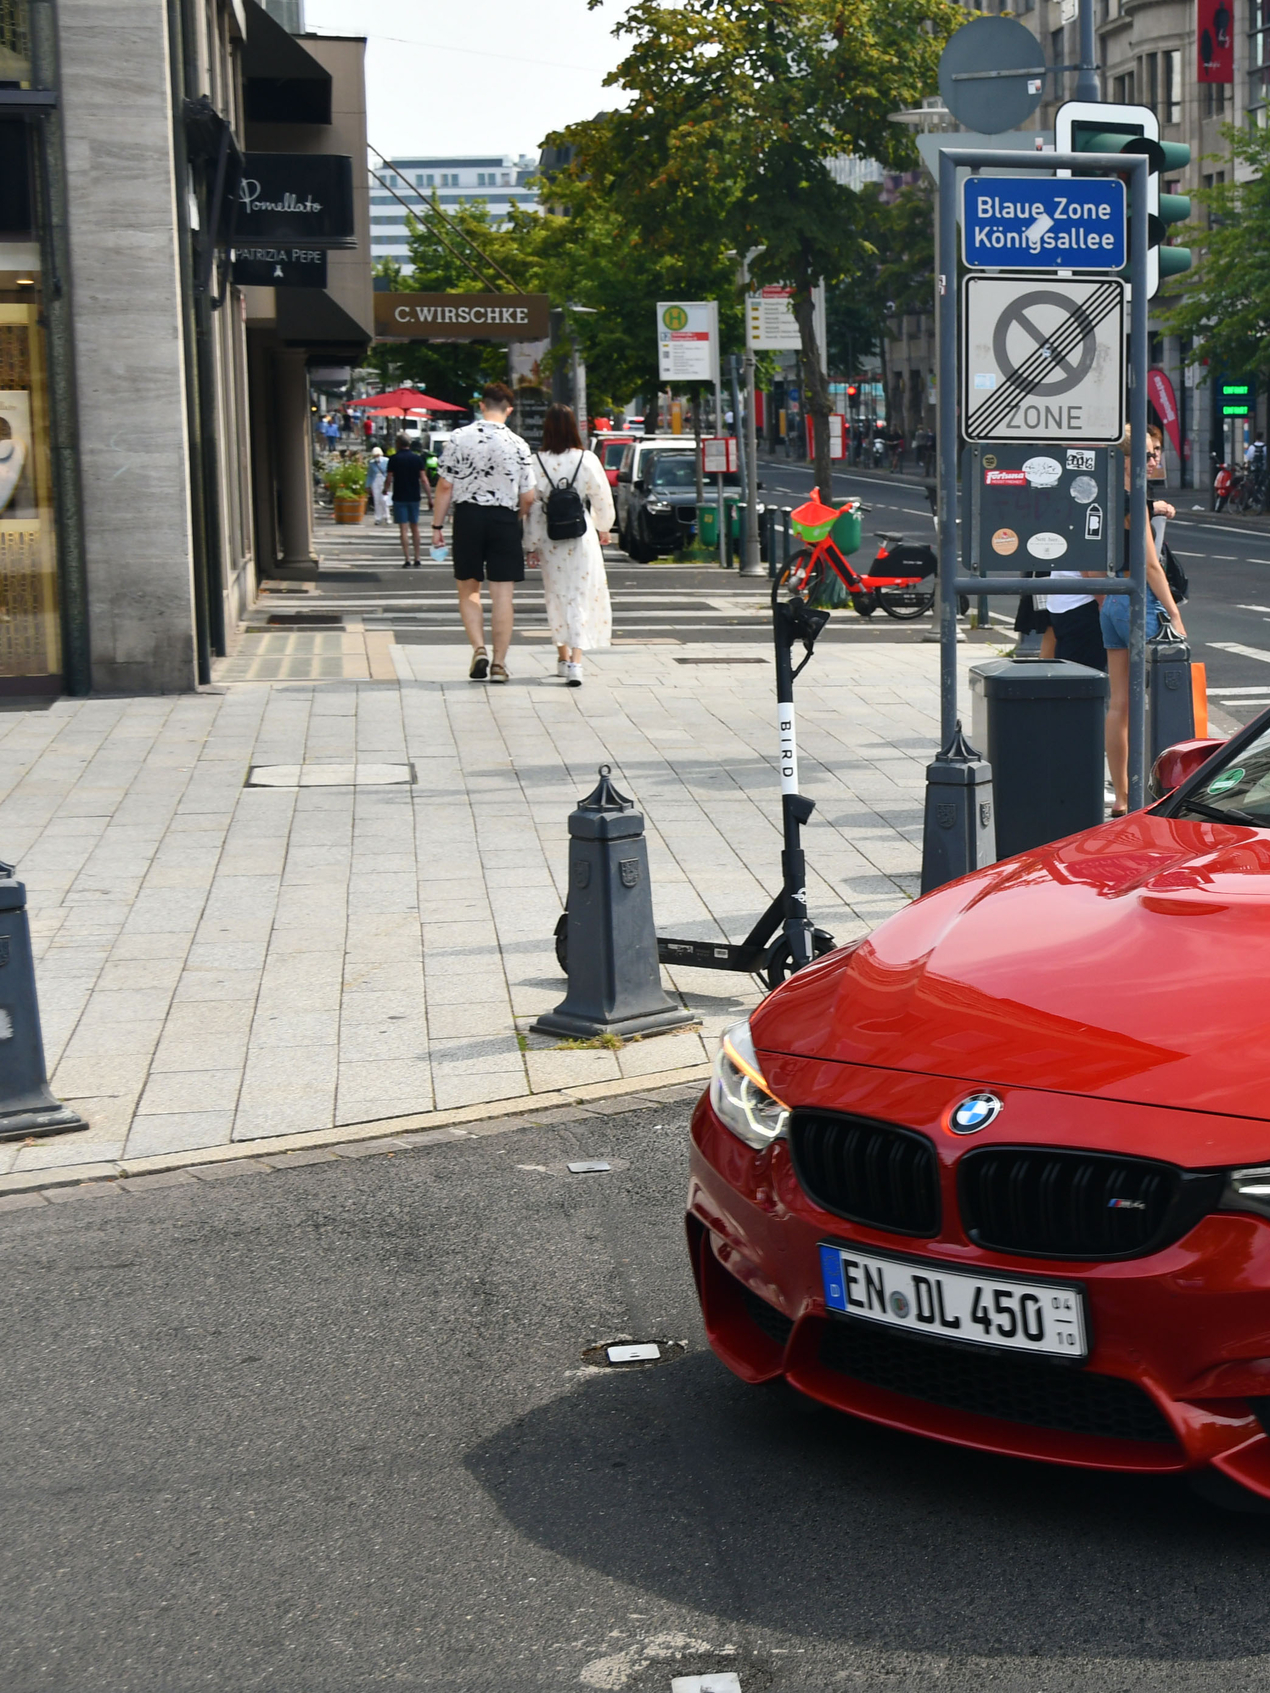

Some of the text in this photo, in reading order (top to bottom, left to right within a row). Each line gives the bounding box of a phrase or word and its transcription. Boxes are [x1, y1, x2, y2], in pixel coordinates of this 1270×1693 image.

[239, 177, 323, 214] Pomellato
[977, 196, 1111, 220] Blaue Zone
[974, 226, 1115, 254] Königsallee
[235, 249, 322, 263] PATRIZIA PEPE
[394, 306, 529, 324] C.WIRSCHKE
[1006, 404, 1082, 430] ZONE
[780, 720, 794, 778] BIRD
[842, 1258, 1045, 1342] EN DL 450
